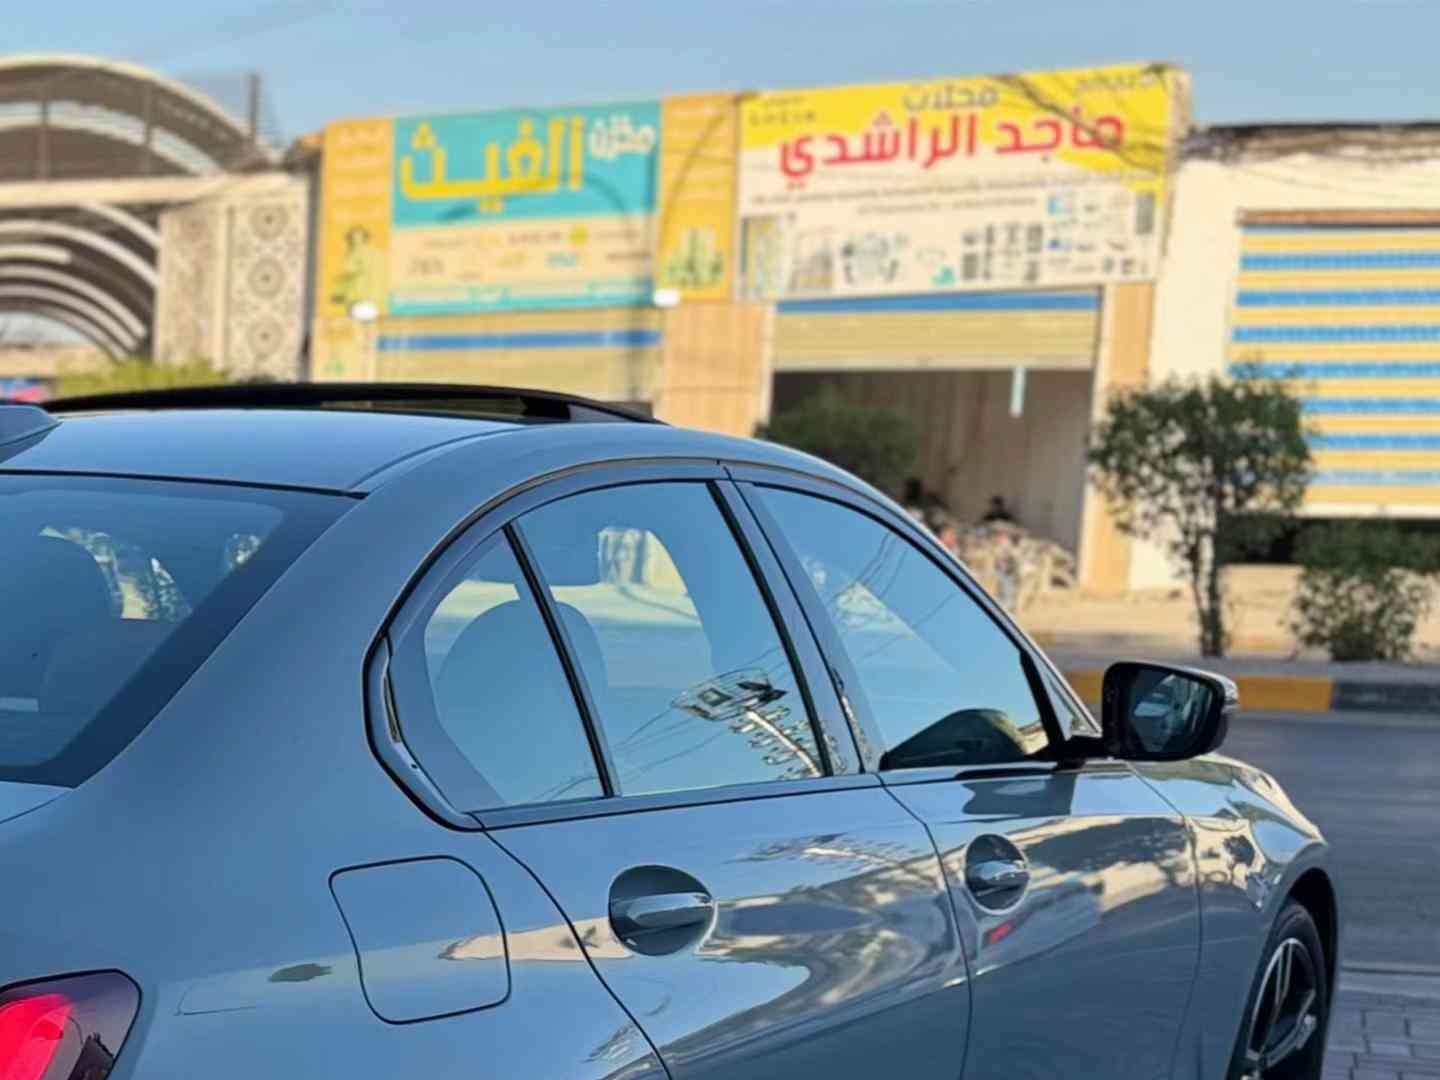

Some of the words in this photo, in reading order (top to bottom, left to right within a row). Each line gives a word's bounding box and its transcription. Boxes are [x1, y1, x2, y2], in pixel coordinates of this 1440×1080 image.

[399, 115, 585, 213] الغيث
[779, 111, 978, 190] الراشدي
[995, 106, 1126, 163] ماجد
